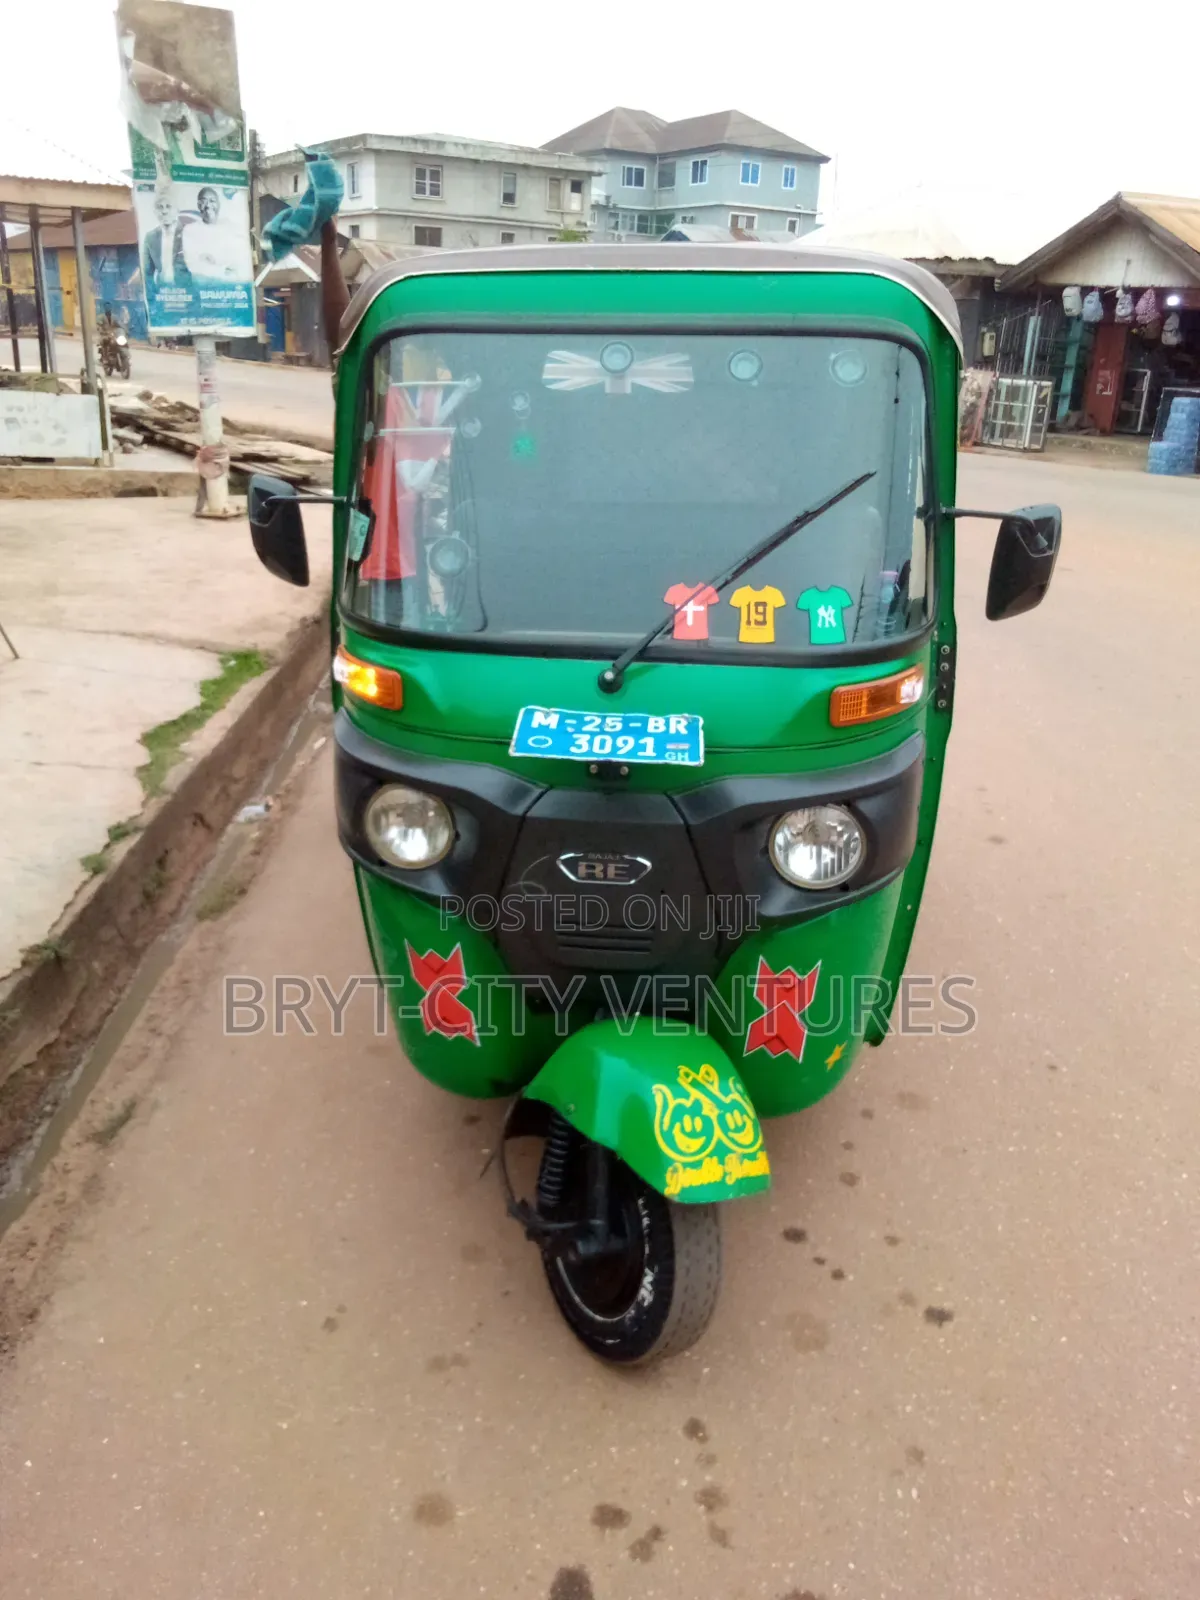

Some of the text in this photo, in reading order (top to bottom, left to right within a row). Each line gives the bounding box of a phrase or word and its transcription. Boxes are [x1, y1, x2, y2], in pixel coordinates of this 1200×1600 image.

[746, 601, 768, 626] 19
[569, 733, 689, 761] 3091 GH
[577, 861, 630, 880] RE
